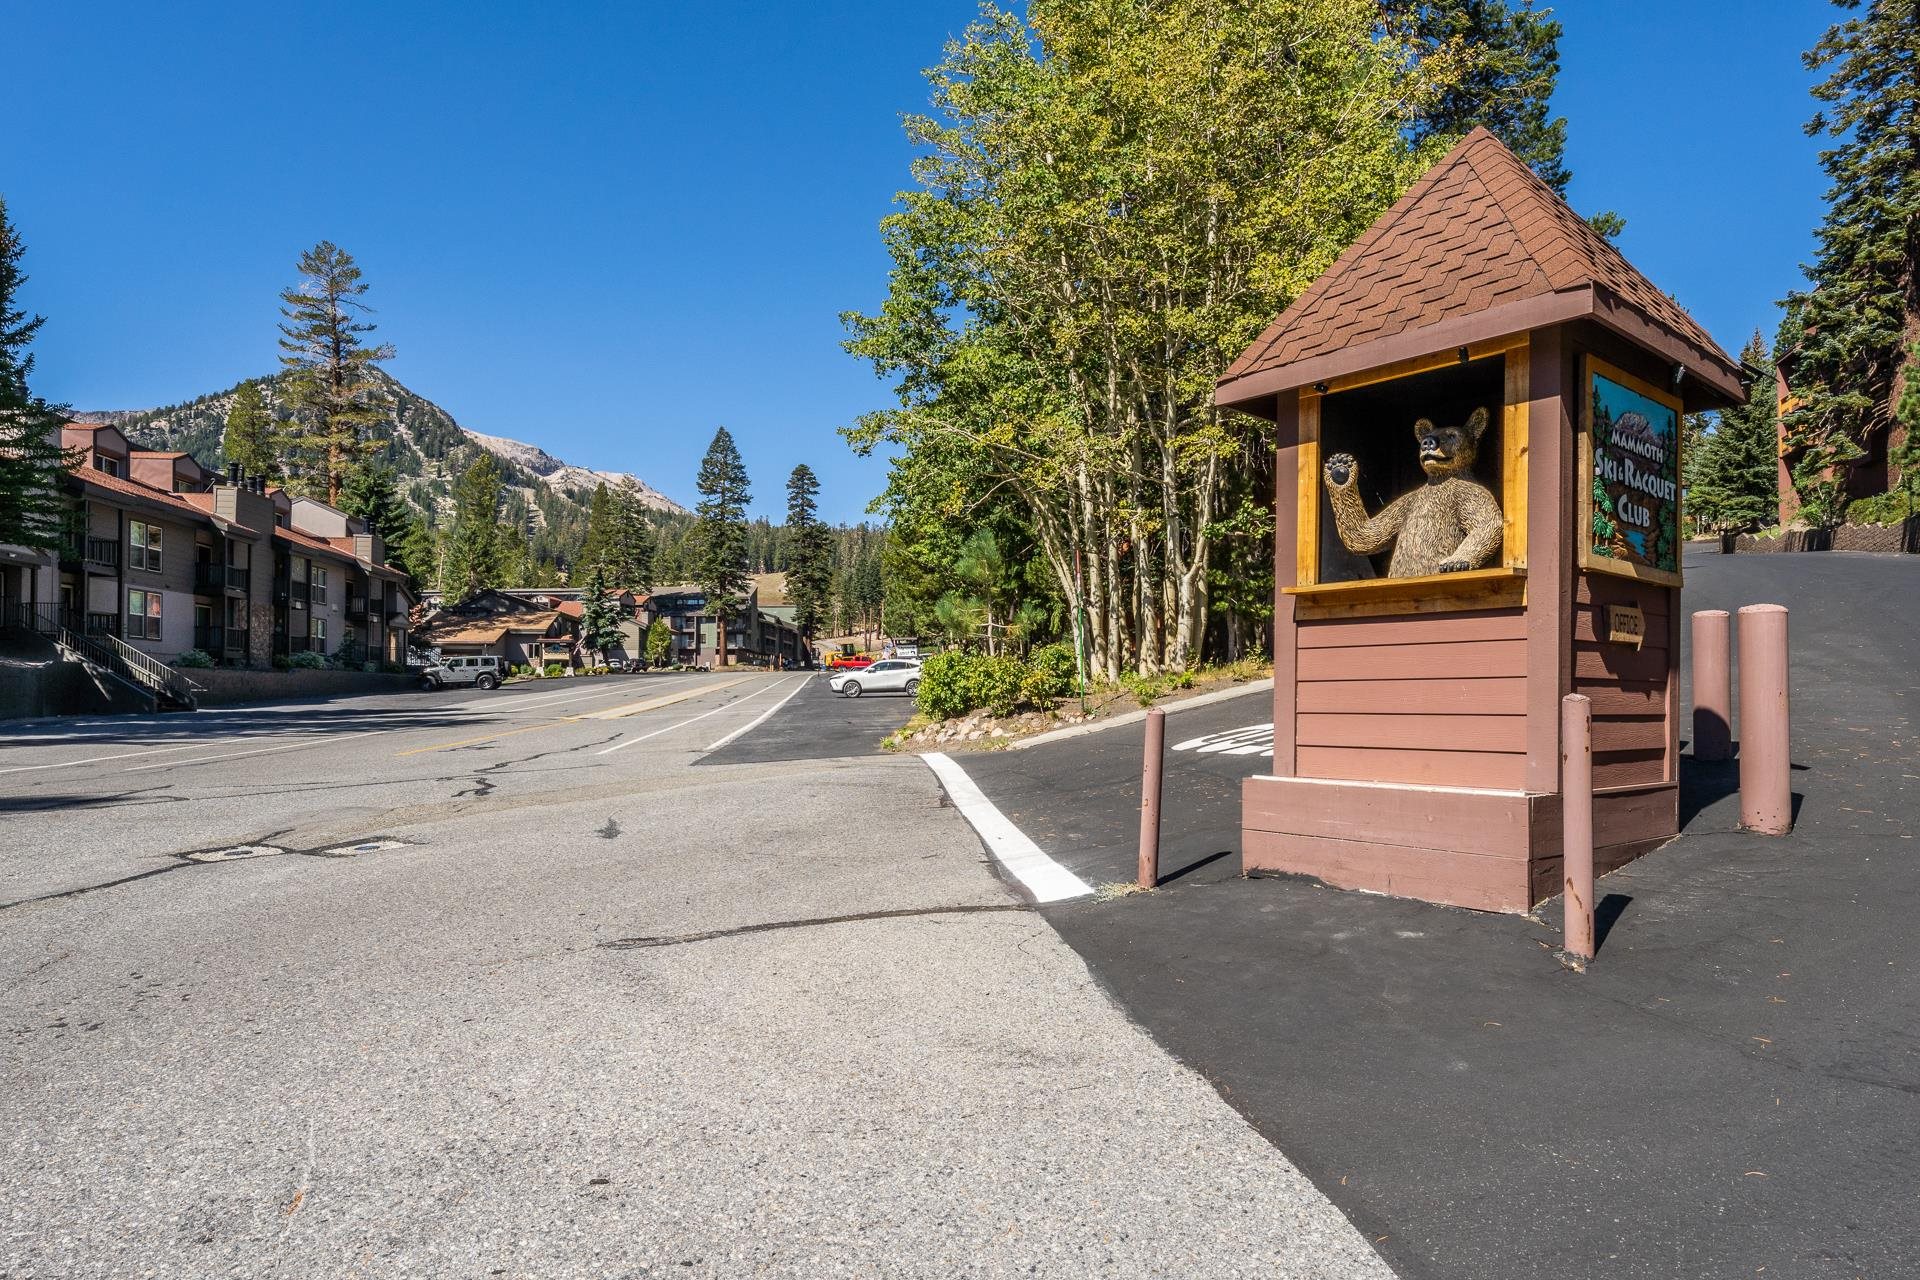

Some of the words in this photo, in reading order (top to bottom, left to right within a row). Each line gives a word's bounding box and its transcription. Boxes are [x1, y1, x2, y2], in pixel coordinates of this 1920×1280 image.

[1611, 429, 1664, 464] MAMMOTH
[1595, 447, 1617, 482] SKI
[1618, 466, 1624, 481] &
[1625, 458, 1677, 501] RACQUET
[1617, 494, 1650, 527] CLUB
[1615, 612, 1638, 635] OFFICE
